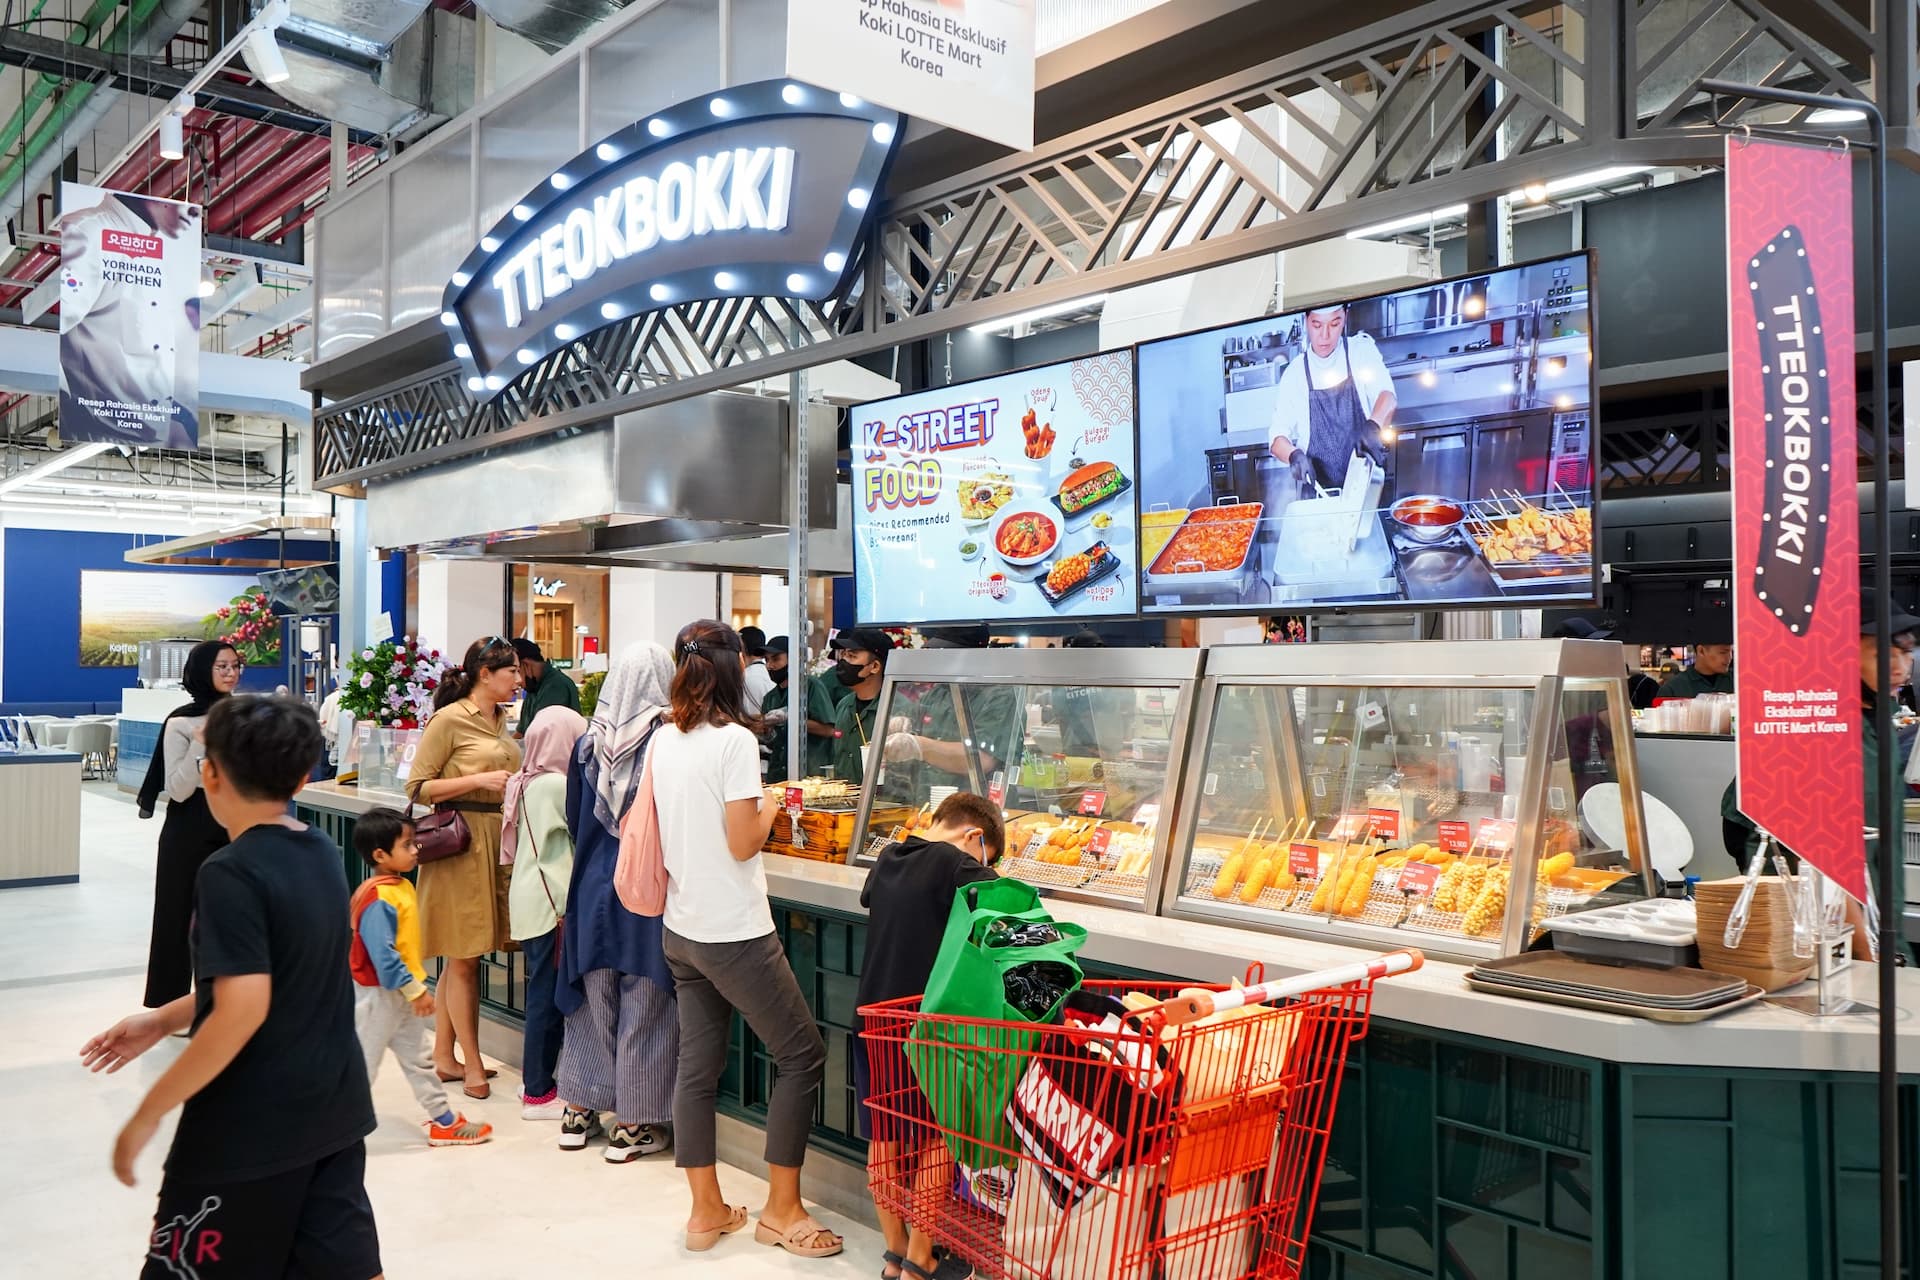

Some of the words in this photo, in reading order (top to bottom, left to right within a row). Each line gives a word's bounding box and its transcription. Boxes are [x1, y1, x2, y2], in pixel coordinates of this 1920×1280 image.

[882, 0, 941, 30] Rahasia
[944, 18, 1008, 55] Eksklusif
[860, 9, 893, 36] Koki
[897, 23, 945, 55] LOTTE
[948, 43, 982, 68] Mart
[901, 48, 943, 77] Korea
[493, 147, 796, 328] TTEOKBOKKI
[102, 259, 162, 276] YORIHADA
[103, 270, 162, 288] KITCHEN
[77, 397, 104, 408] Resep
[106, 400, 141, 410] Rahasia
[142, 403, 181, 415] Eksklusif
[93, 408, 114, 417] Koki
[115, 410, 143, 420] LOTTE
[144, 413, 166, 422] Mart
[117, 420, 143, 429] Korea
[864, 398, 999, 464] K-STREET
[1772, 294, 1811, 565] TTEOKBOKKI
[865, 459, 942, 512] FOOD
[891, 512, 950, 529] Recommended
[1763, 690, 1795, 704] Resep
[1796, 688, 1838, 701] Rahasia
[1764, 705, 1812, 717] Eksklusif
[1813, 704, 1837, 717] Koki
[1754, 722, 1789, 734] LOTTE
[1790, 722, 1816, 733] Mart
[1817, 721, 1848, 732] Korea
[1016, 1056, 1114, 1180] MARVEL
